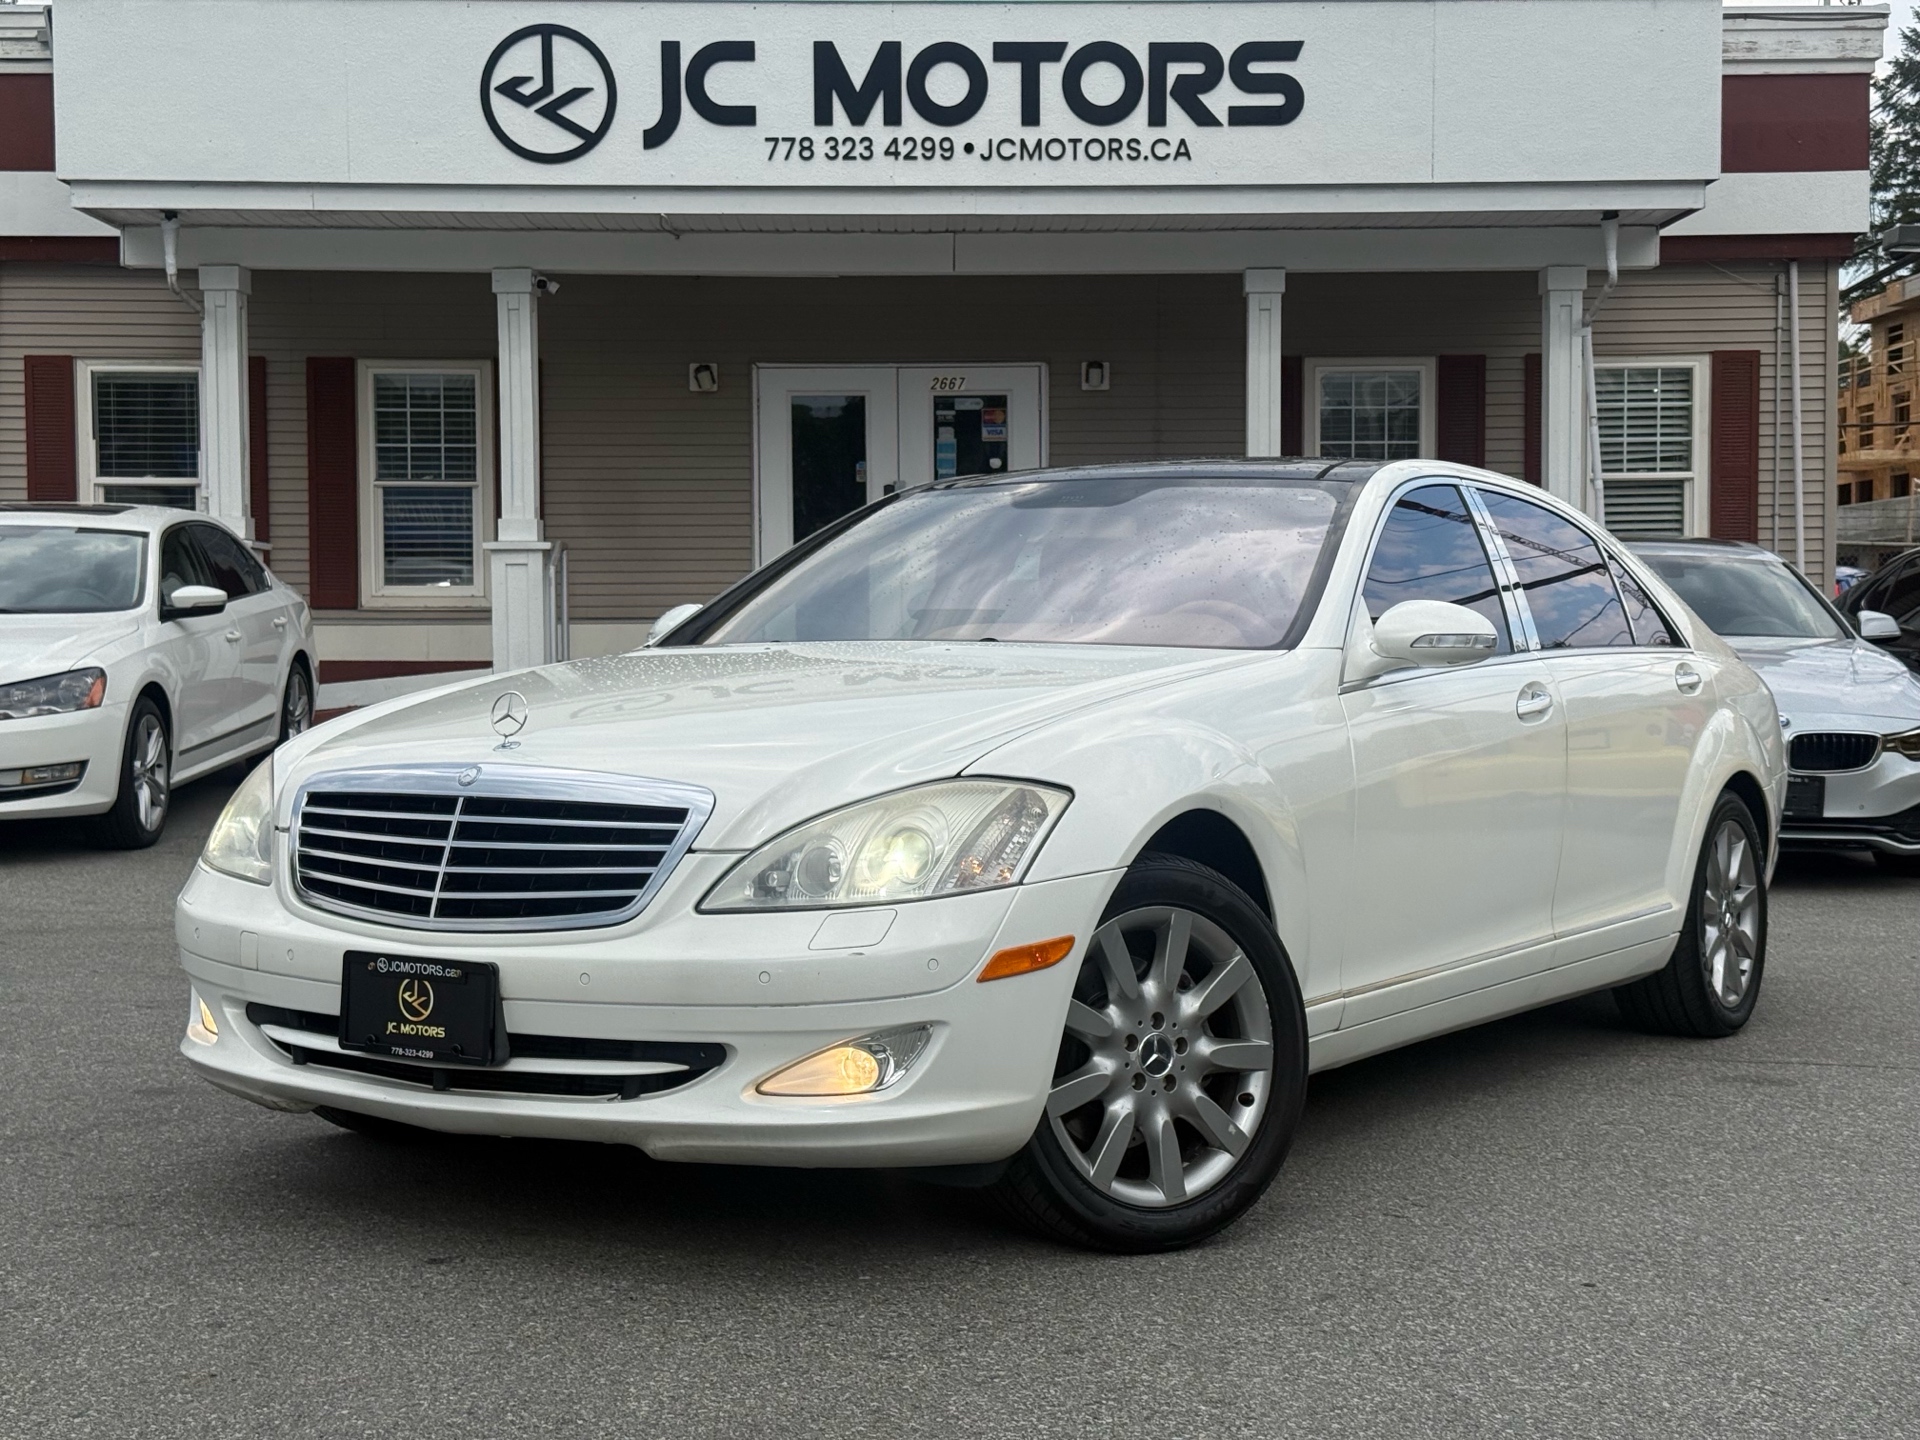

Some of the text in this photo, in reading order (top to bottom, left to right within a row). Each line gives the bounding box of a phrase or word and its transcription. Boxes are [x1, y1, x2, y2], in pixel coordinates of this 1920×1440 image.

[643, 41, 1304, 150] JC MOTORS
[765, 136, 814, 161] 778
[825, 136, 874, 161] 323
[884, 136, 954, 161] 4299
[931, 377, 965, 390] 2667
[400, 1023, 445, 1038] MOTORS
[391, 1046, 434, 1059] 778-323-4299
